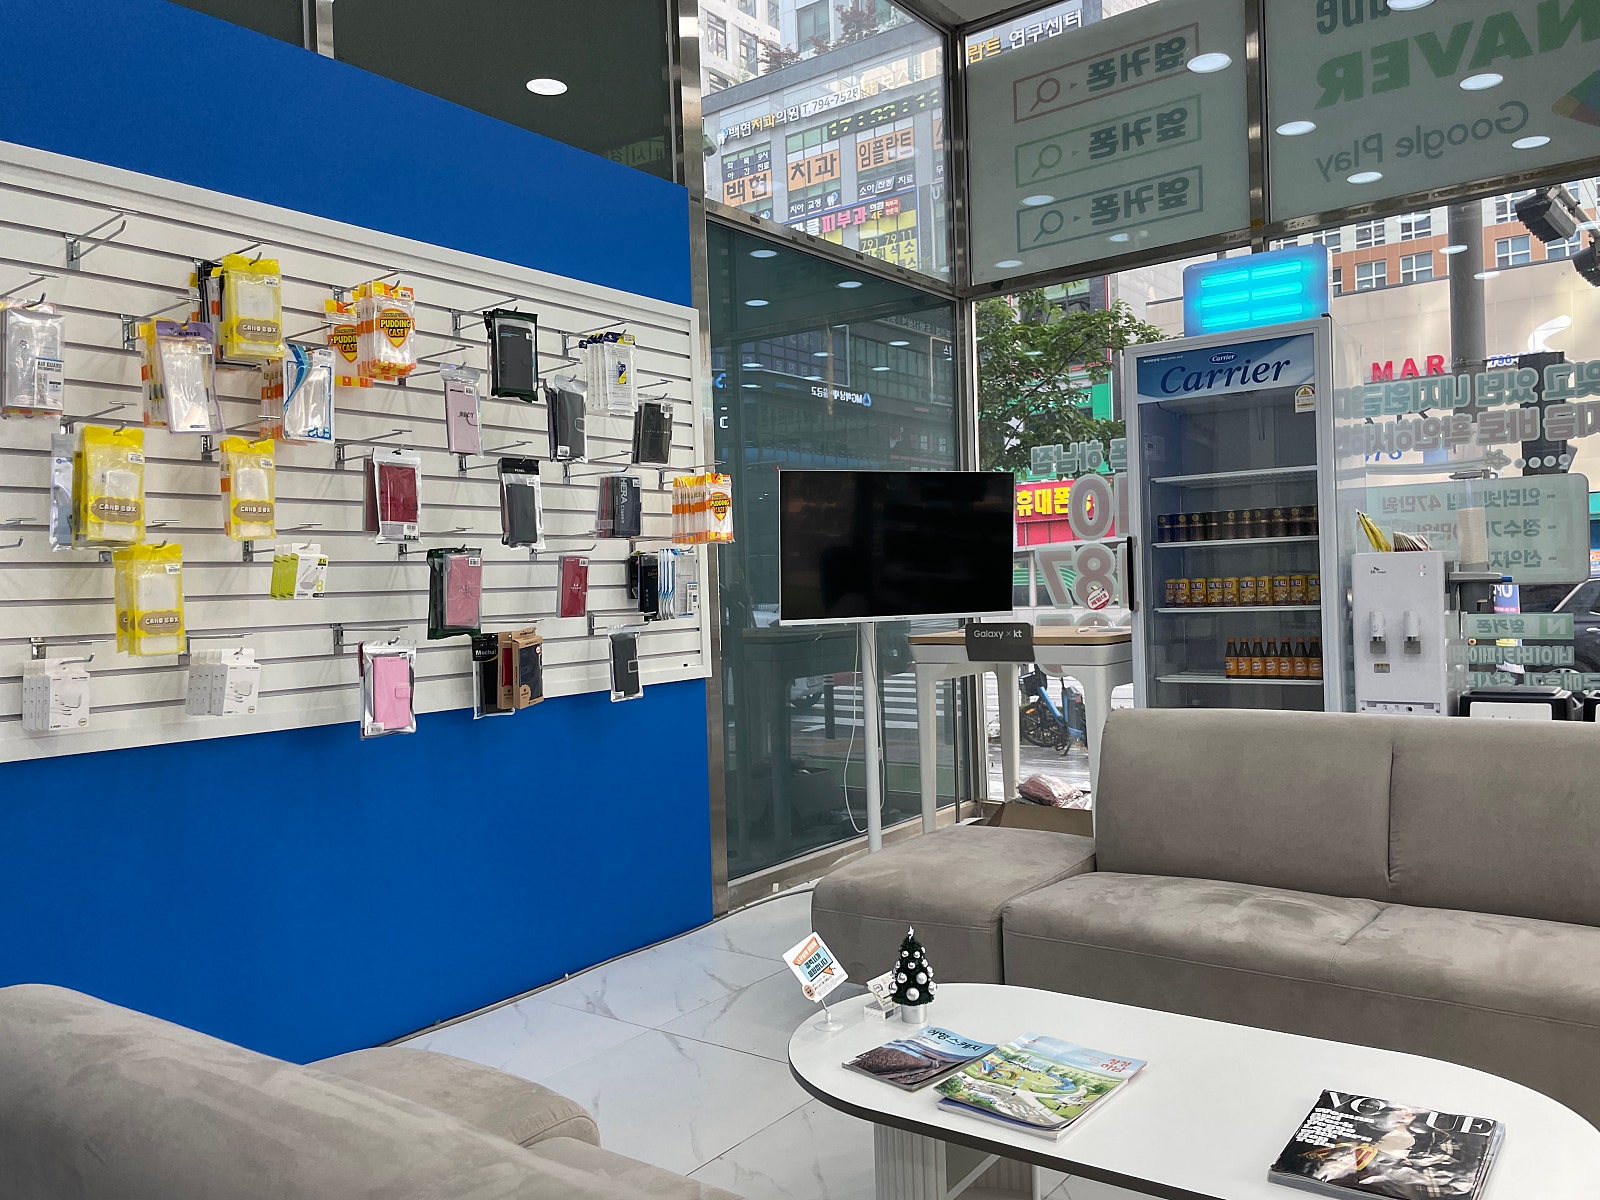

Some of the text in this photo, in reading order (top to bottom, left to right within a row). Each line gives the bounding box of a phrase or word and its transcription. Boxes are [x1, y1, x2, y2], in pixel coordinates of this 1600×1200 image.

[1009, 9, 1083, 50] 연구센터
[802, 87, 860, 114] T.794-7528
[859, 130, 913, 169] 임플란트
[791, 153, 837, 184] 치과
[726, 172, 768, 202] 백현
[859, 184, 875, 196] 소아
[897, 174, 914, 185] 치료
[789, 198, 822, 214] 치아 교정
[869, 201, 884, 212] 의원
[870, 211, 883, 220] 4F
[861, 238, 879, 251] 791
[885, 234, 898, 246] 79
[380, 318, 412, 329] PUDDING
[333, 335, 357, 344] PUDDI
[388, 328, 405, 338] CASE
[1211, 353, 1236, 362] Carrier
[1160, 359, 1290, 394] Carrier
[709, 499, 731, 507] PUDDING
[973, 629, 1023, 640] Galaxy kt
[1328, 1091, 1496, 1137] VOUE
